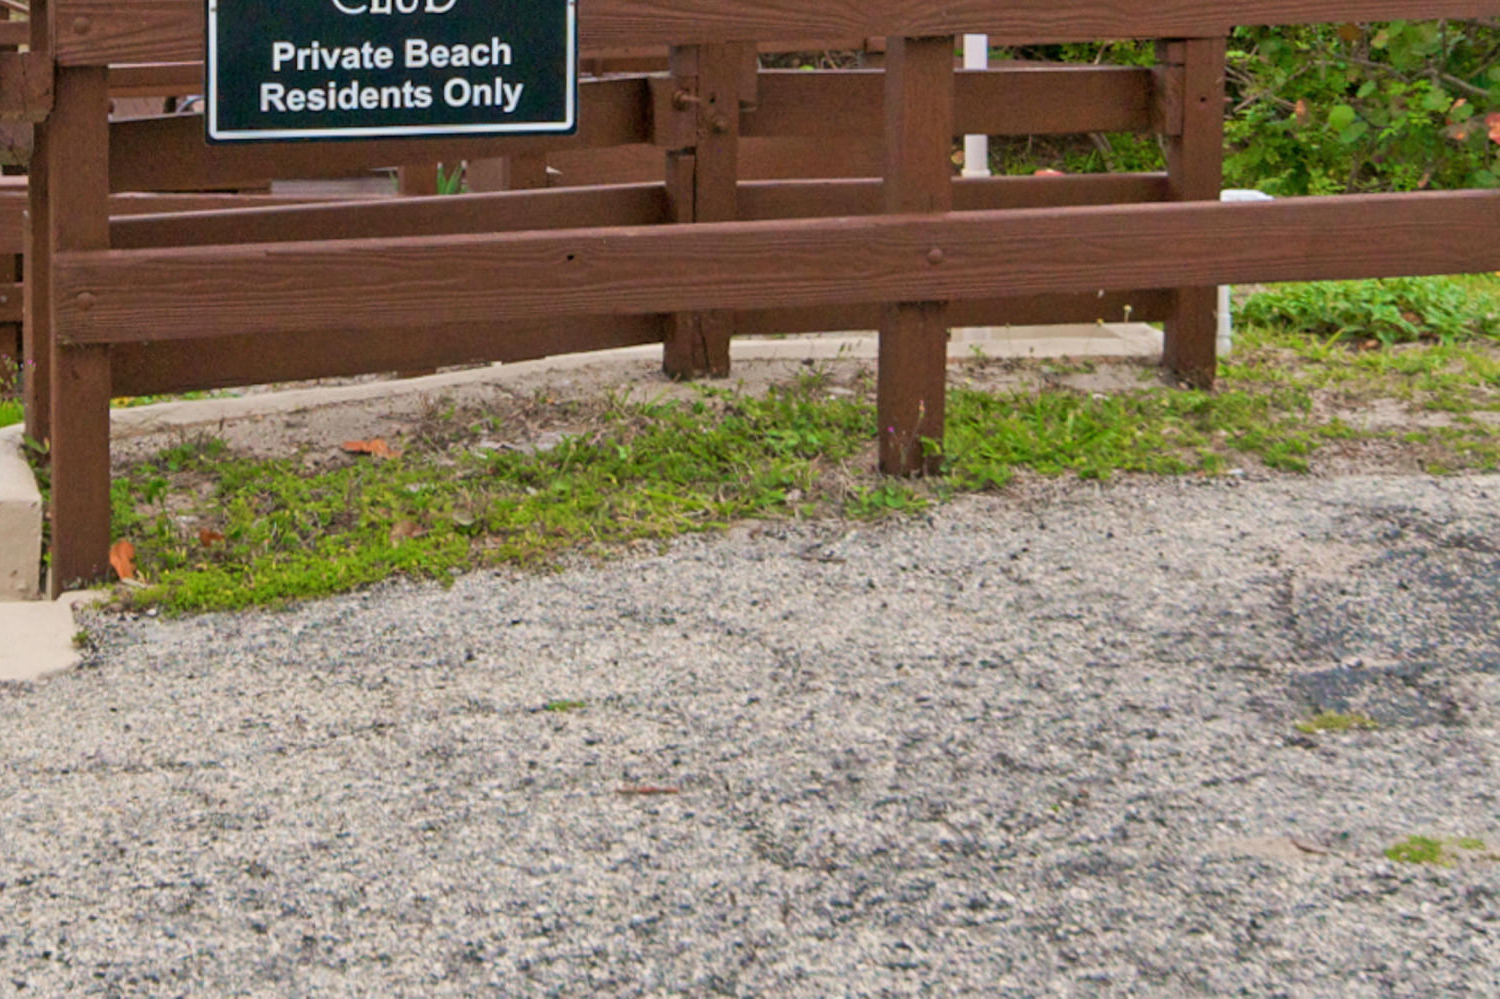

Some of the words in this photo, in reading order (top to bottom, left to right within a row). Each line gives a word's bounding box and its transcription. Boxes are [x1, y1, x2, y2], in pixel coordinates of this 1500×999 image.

[272, 41, 394, 72] Private
[404, 37, 511, 68] Beach
[260, 80, 433, 112] Residents
[443, 77, 524, 112] Only
